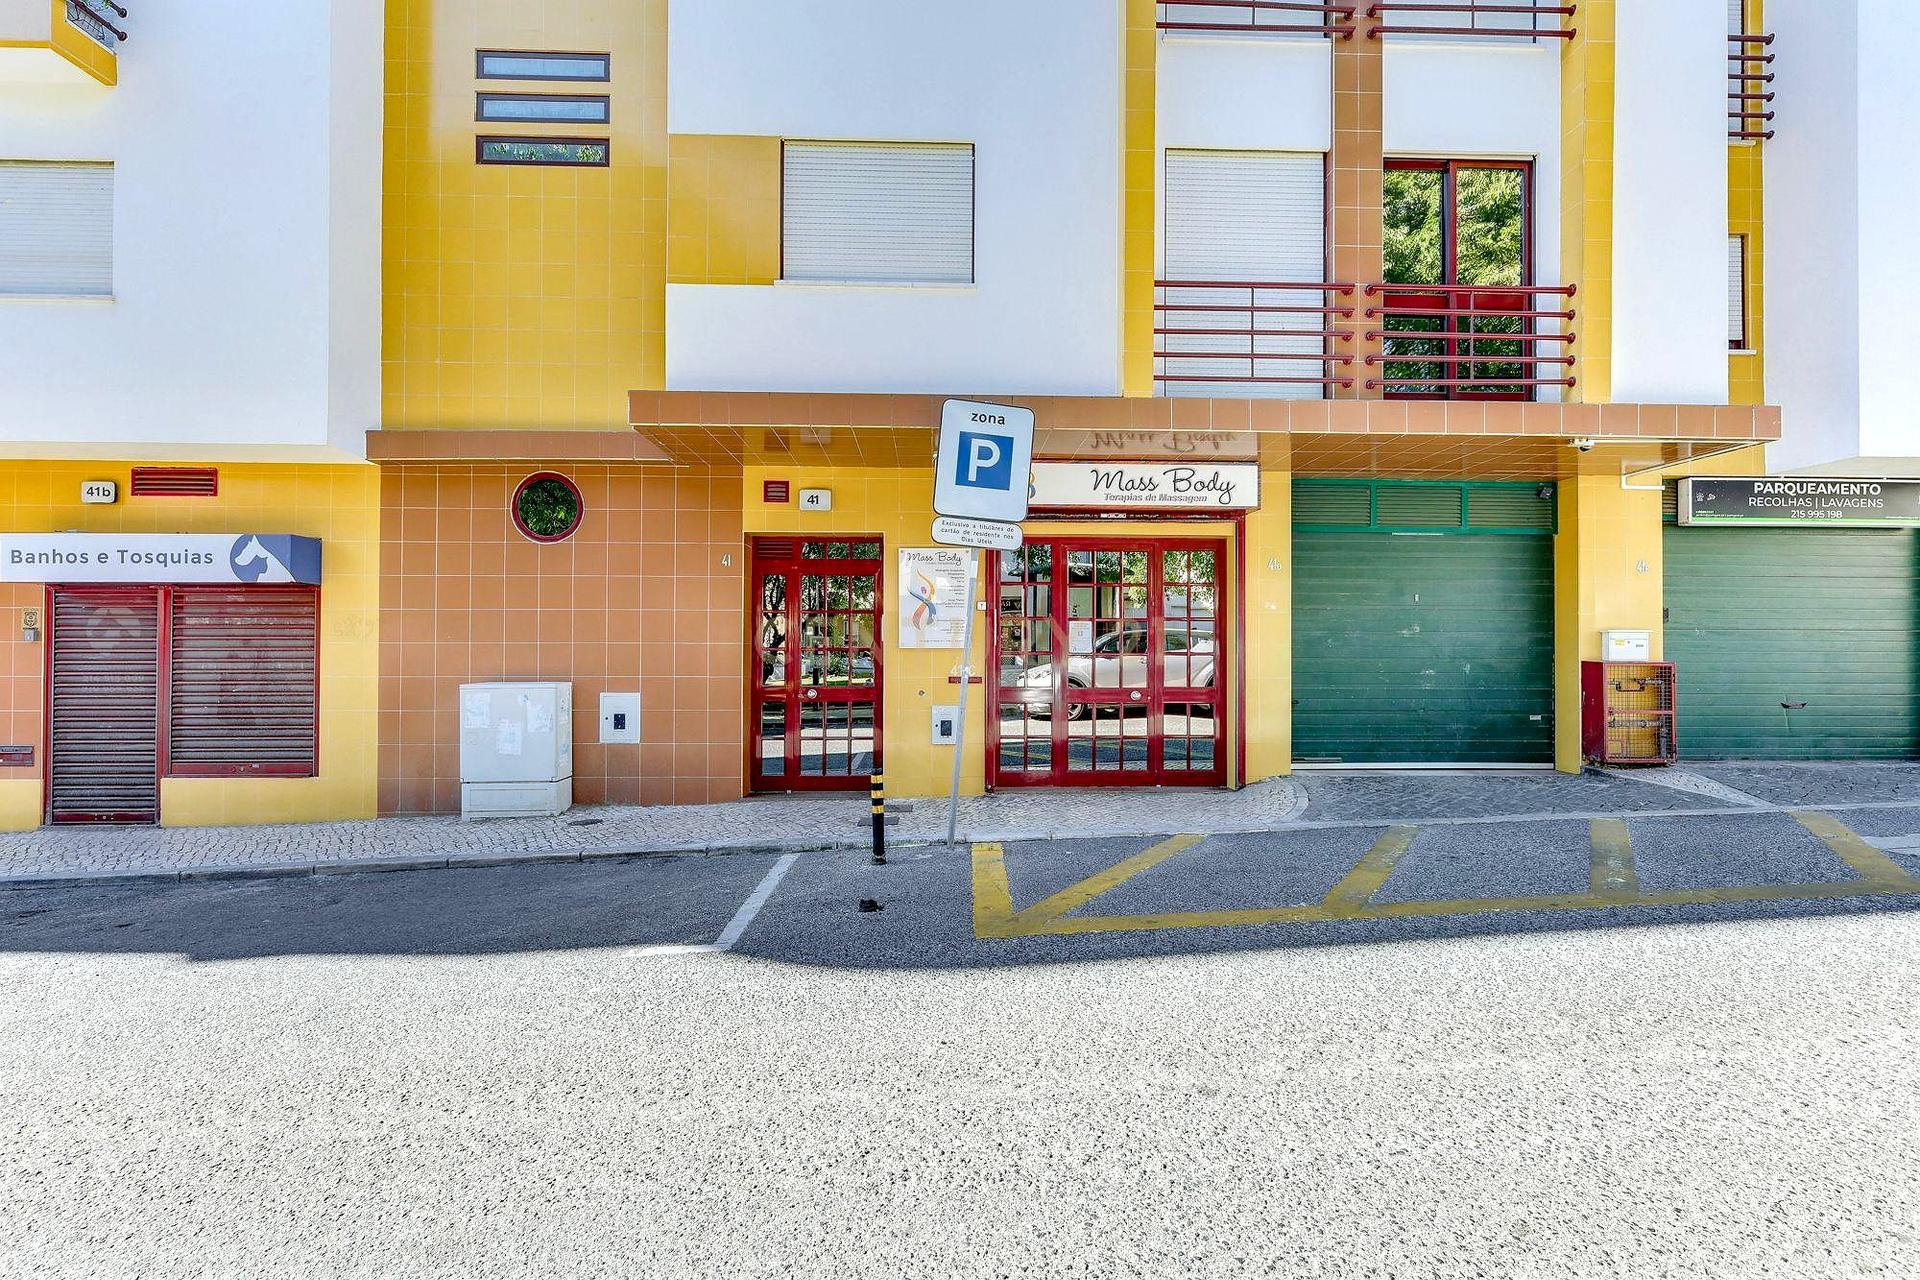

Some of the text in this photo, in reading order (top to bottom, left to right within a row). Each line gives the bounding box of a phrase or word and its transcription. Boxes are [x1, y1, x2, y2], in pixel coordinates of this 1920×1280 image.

[971, 411, 1006, 426] zona
[967, 438, 1001, 482] P
[86, 486, 111, 498] 41b
[1090, 467, 1237, 505] Mass Body
[1753, 482, 1882, 496] PARQUEAMENTO
[807, 495, 819, 505] 41
[1104, 492, 1143, 502] Terapias
[1158, 493, 1208, 503] Massagem
[1748, 497, 1884, 508] RECOLHAS LAVAGENS
[1791, 510, 1843, 519] 215 995 198
[942, 520, 969, 528] Exclusivo
[973, 531, 1001, 539] residente
[10, 549, 214, 568] Banhos e Tosquias
[721, 553, 731, 567] 41
[907, 551, 963, 566] Mass Body
